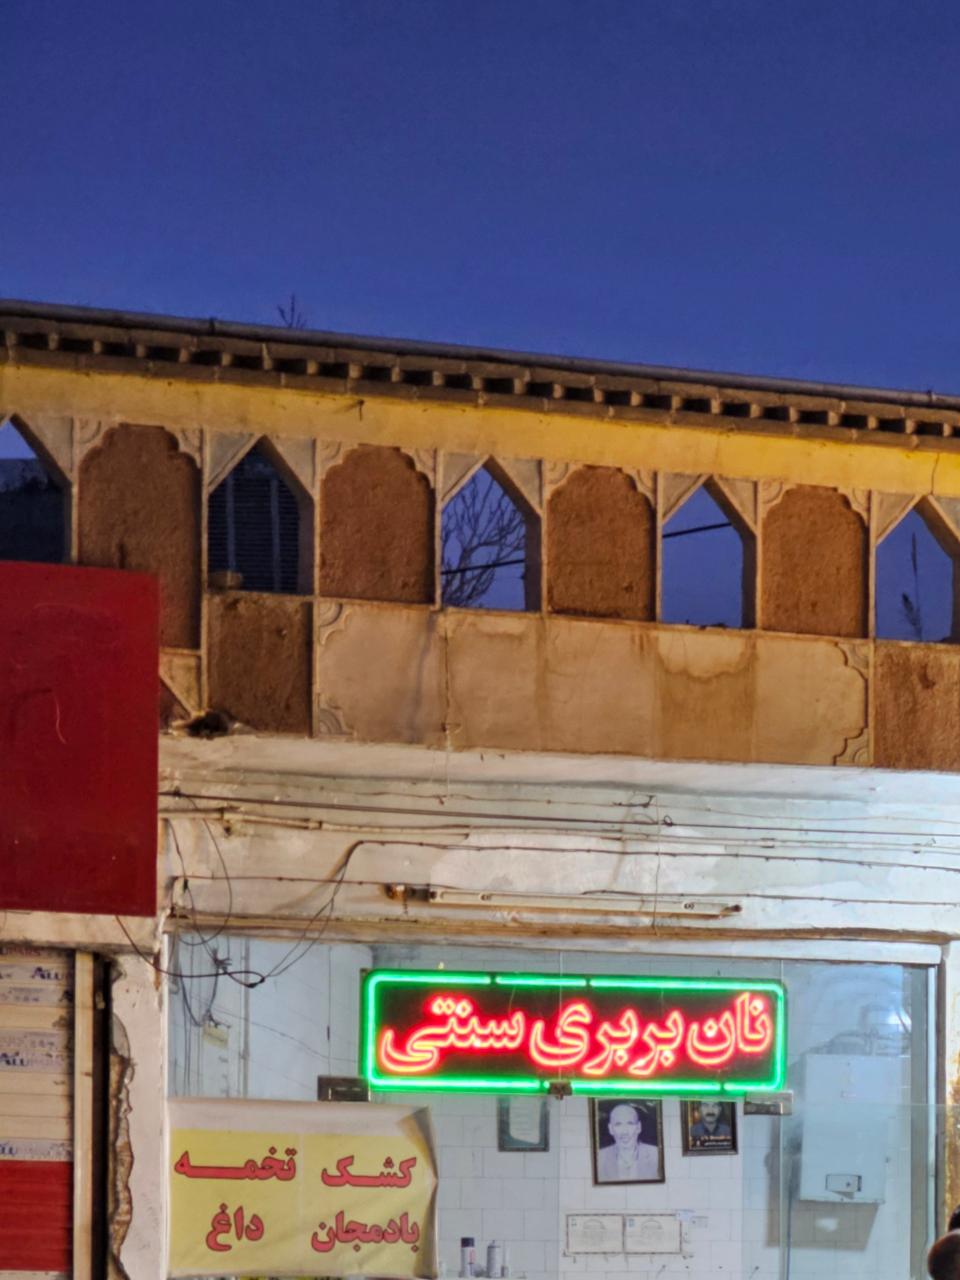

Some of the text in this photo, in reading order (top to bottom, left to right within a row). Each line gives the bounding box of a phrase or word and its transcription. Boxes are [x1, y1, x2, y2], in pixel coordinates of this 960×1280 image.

[379, 992, 772, 1075] نان بربری سنتی
[174, 1146, 297, 1181] تخمه
[321, 1155, 417, 1188] کشک
[206, 1202, 265, 1251] داغ
[311, 1210, 420, 1252] بادمجان
